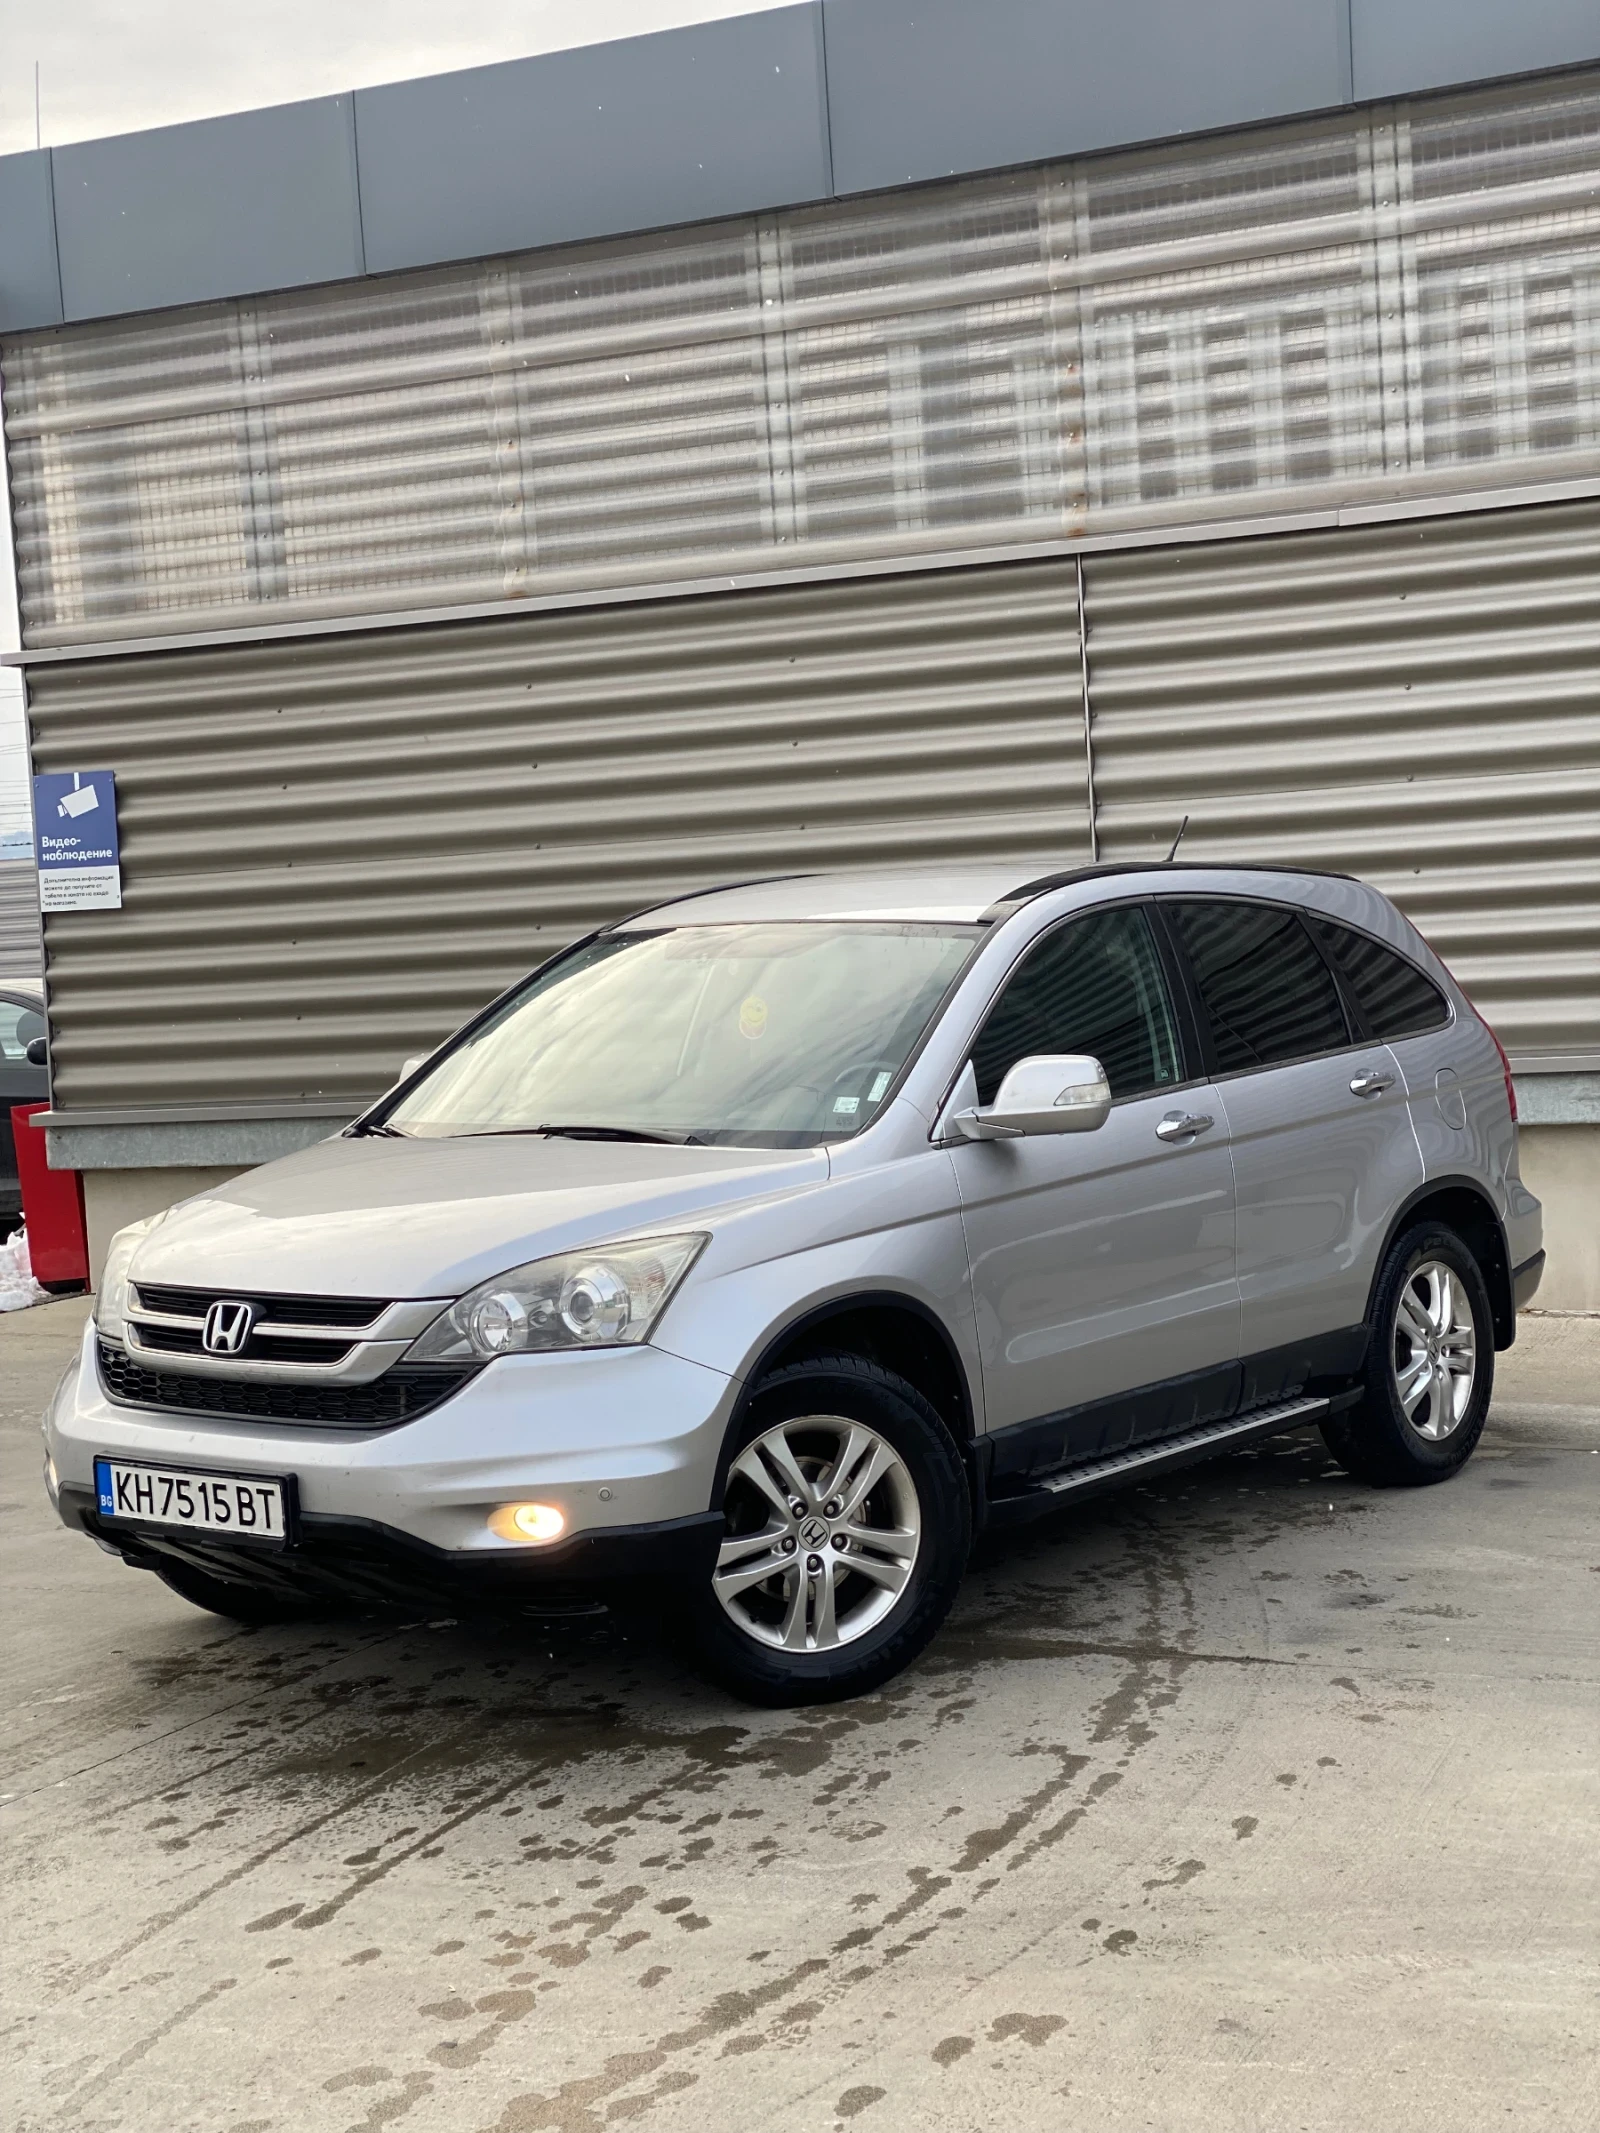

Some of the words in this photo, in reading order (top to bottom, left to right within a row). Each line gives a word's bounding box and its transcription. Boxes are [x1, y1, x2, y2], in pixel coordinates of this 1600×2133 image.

[42, 836, 81, 849] Видео-
[42, 849, 112, 861] наблюдение
[101, 1494, 113, 1507] BG
[115, 1471, 275, 1529] KH7515BT
